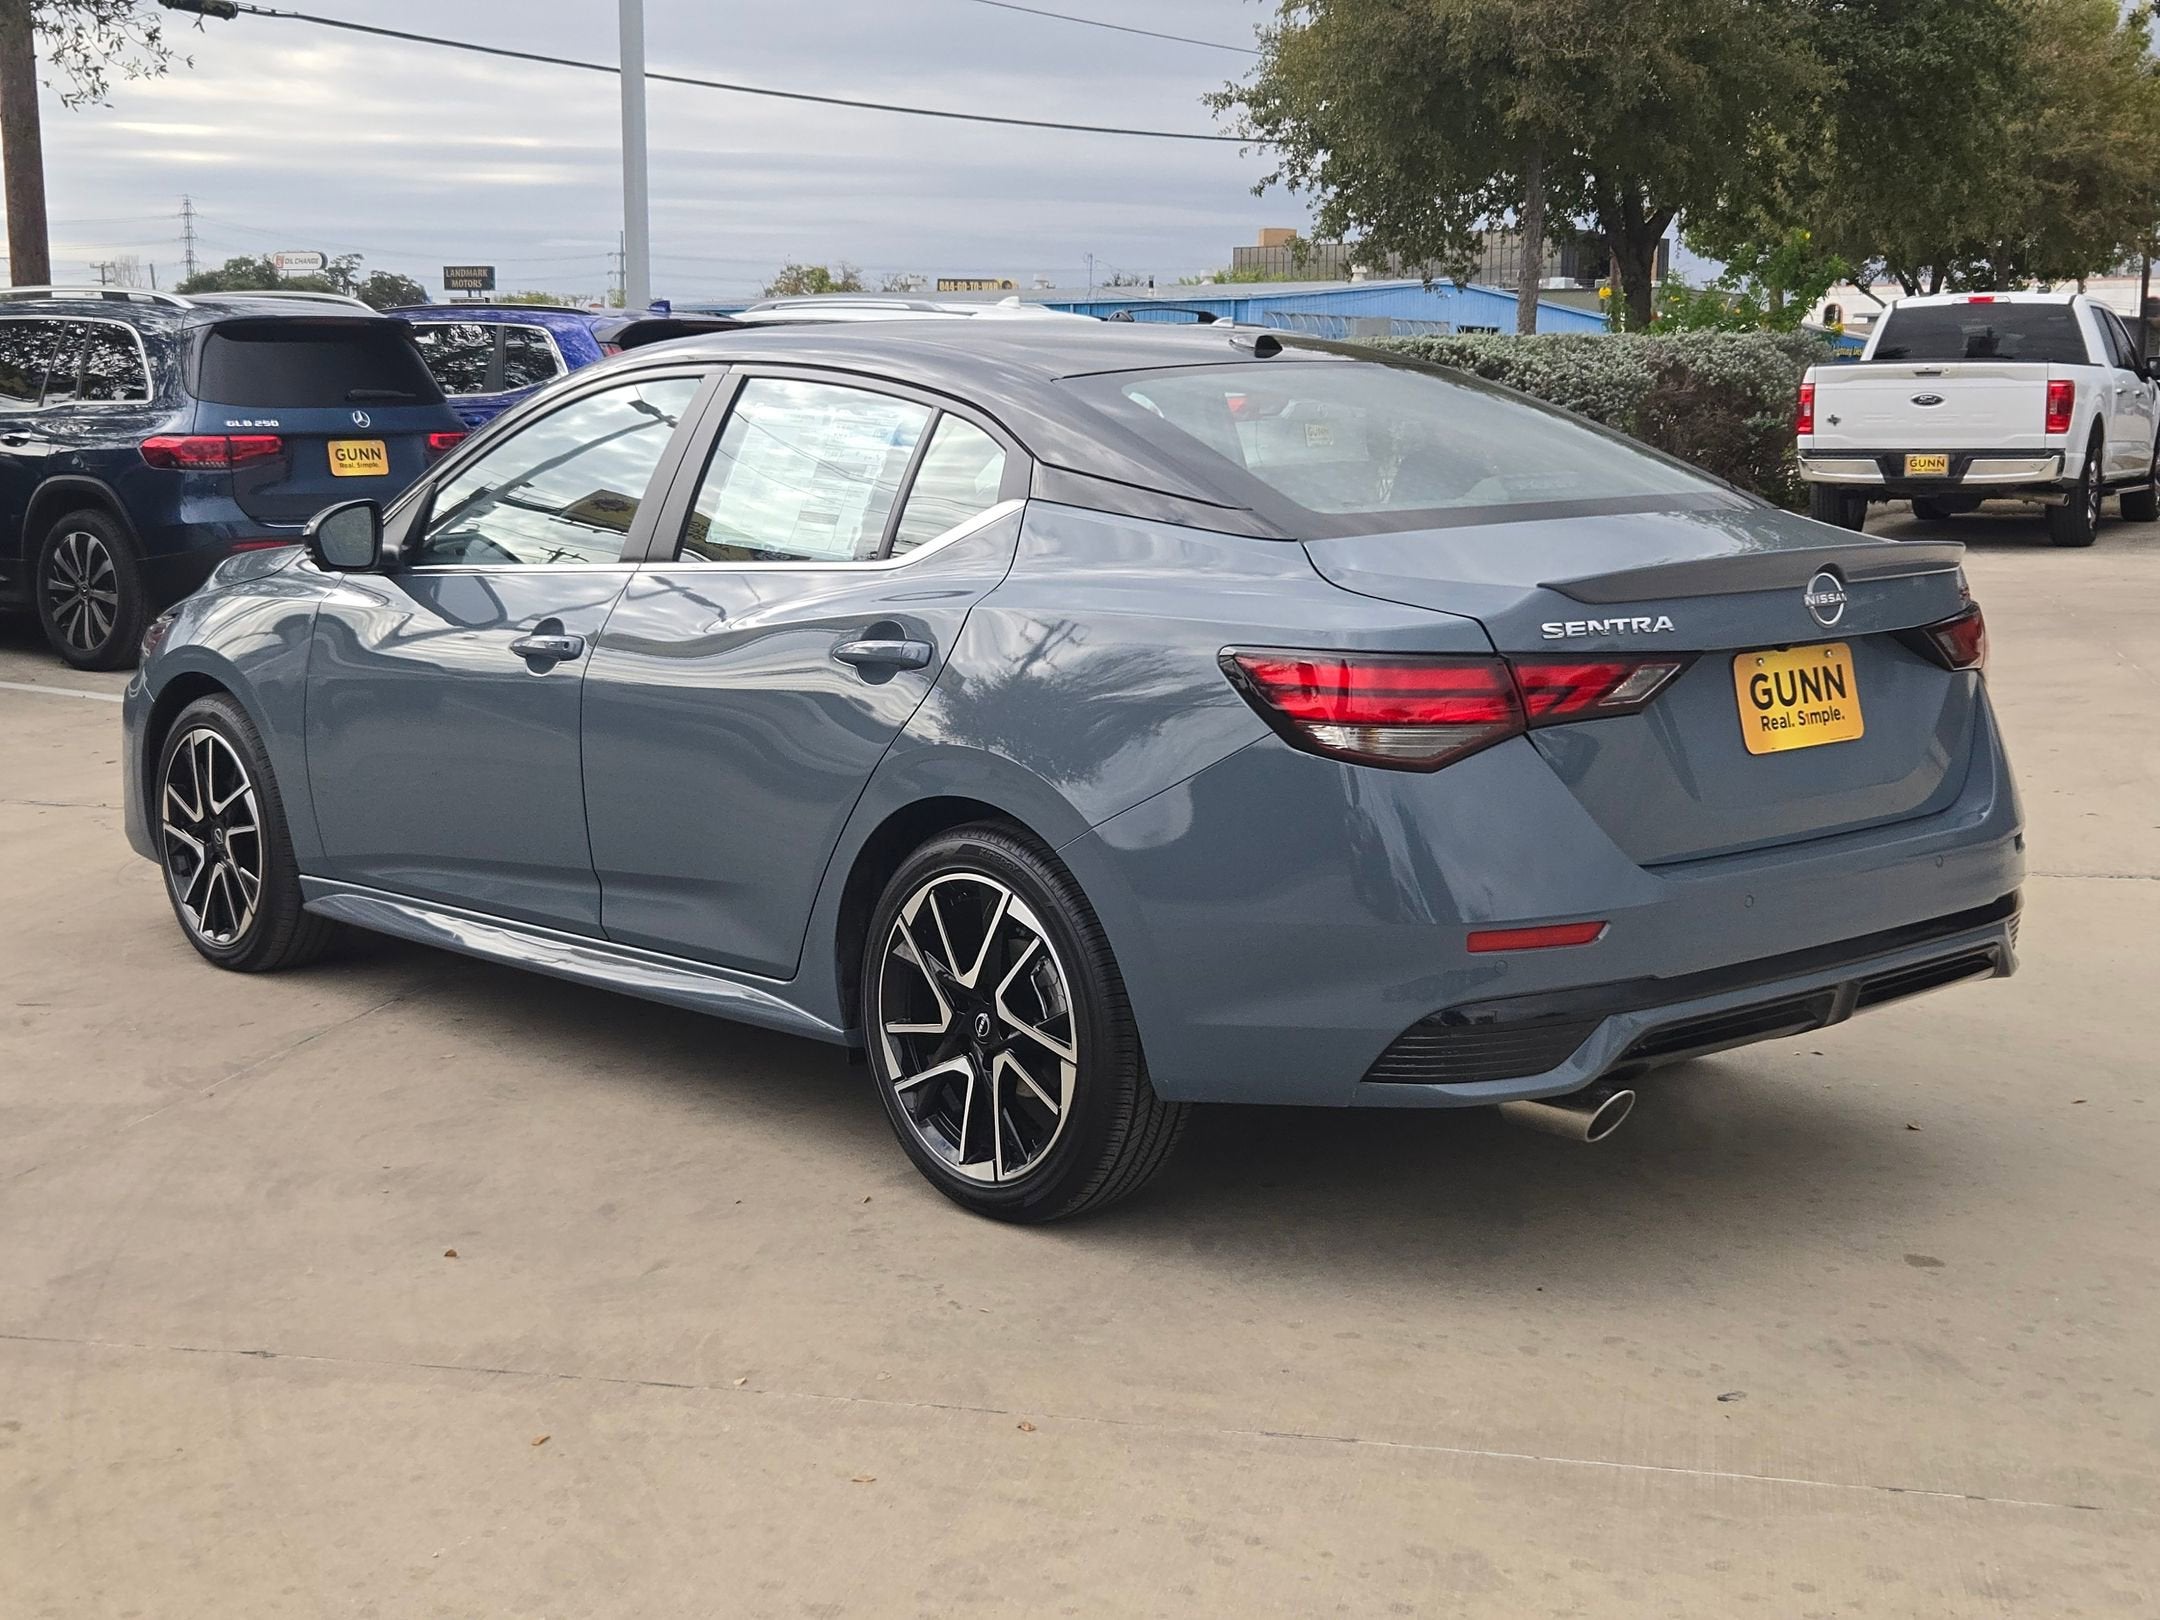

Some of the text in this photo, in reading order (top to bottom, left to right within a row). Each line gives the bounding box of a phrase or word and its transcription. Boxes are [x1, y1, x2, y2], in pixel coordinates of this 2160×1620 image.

[445, 268, 488, 278] LANDMARK
[451, 279, 482, 288] MOTORS
[335, 448, 382, 462] GUNN
[1909, 459, 1945, 468] GUNN
[1804, 592, 1847, 606] NISSAN
[1540, 615, 1675, 640] SENTRA
[1750, 664, 1847, 710] GUNN
[1760, 706, 1845, 732] Real. Simple.
